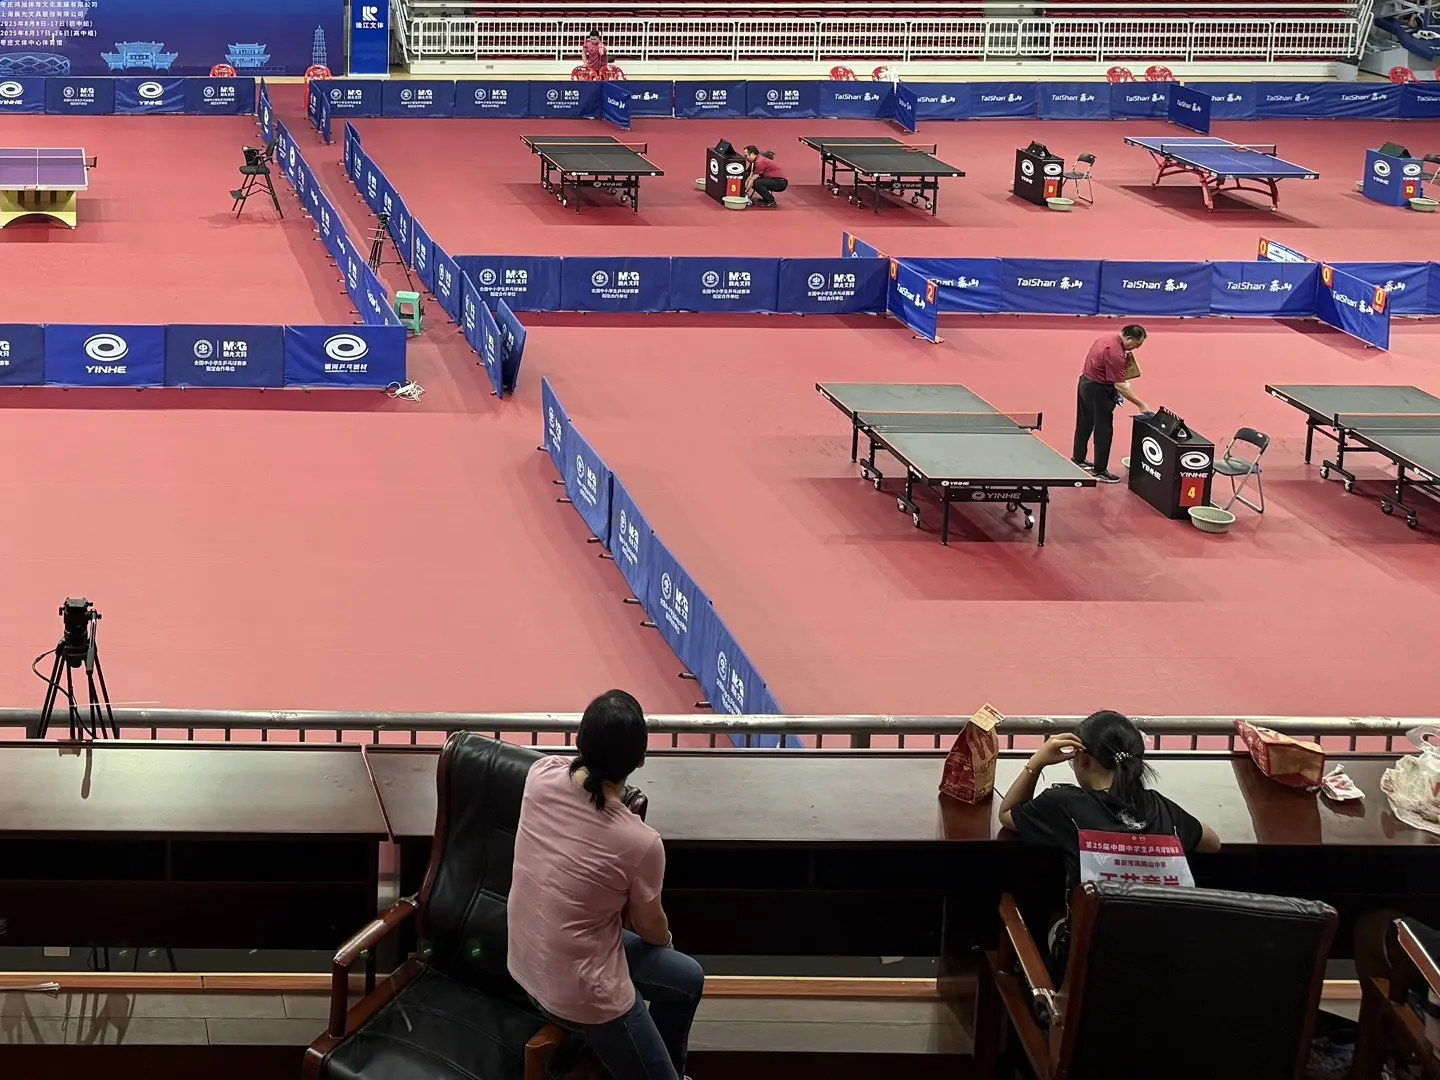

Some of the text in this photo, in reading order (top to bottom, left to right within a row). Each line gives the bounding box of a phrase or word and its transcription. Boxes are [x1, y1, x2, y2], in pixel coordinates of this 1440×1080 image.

[731, 184, 736, 192] 5
[1405, 186, 1414, 194] 13
[1260, 241, 1266, 254] 0
[505, 269, 528, 279] M&G
[891, 264, 896, 275] 0
[618, 271, 639, 280] M&G
[728, 271, 751, 281] M&G
[833, 273, 855, 283] M&G
[1323, 268, 1329, 282] 0
[1018, 278, 1056, 286] TaiShan
[1123, 280, 1161, 289] TaiShan
[1228, 282, 1265, 290] TaiShan
[927, 288, 933, 300] 2
[1332, 290, 1358, 308] TaiShan
[1375, 290, 1382, 304] 0
[223, 341, 248, 351] M&G
[86, 366, 127, 374] YINHE
[1141, 461, 1162, 480] YINHE
[1188, 487, 1196, 498] 4
